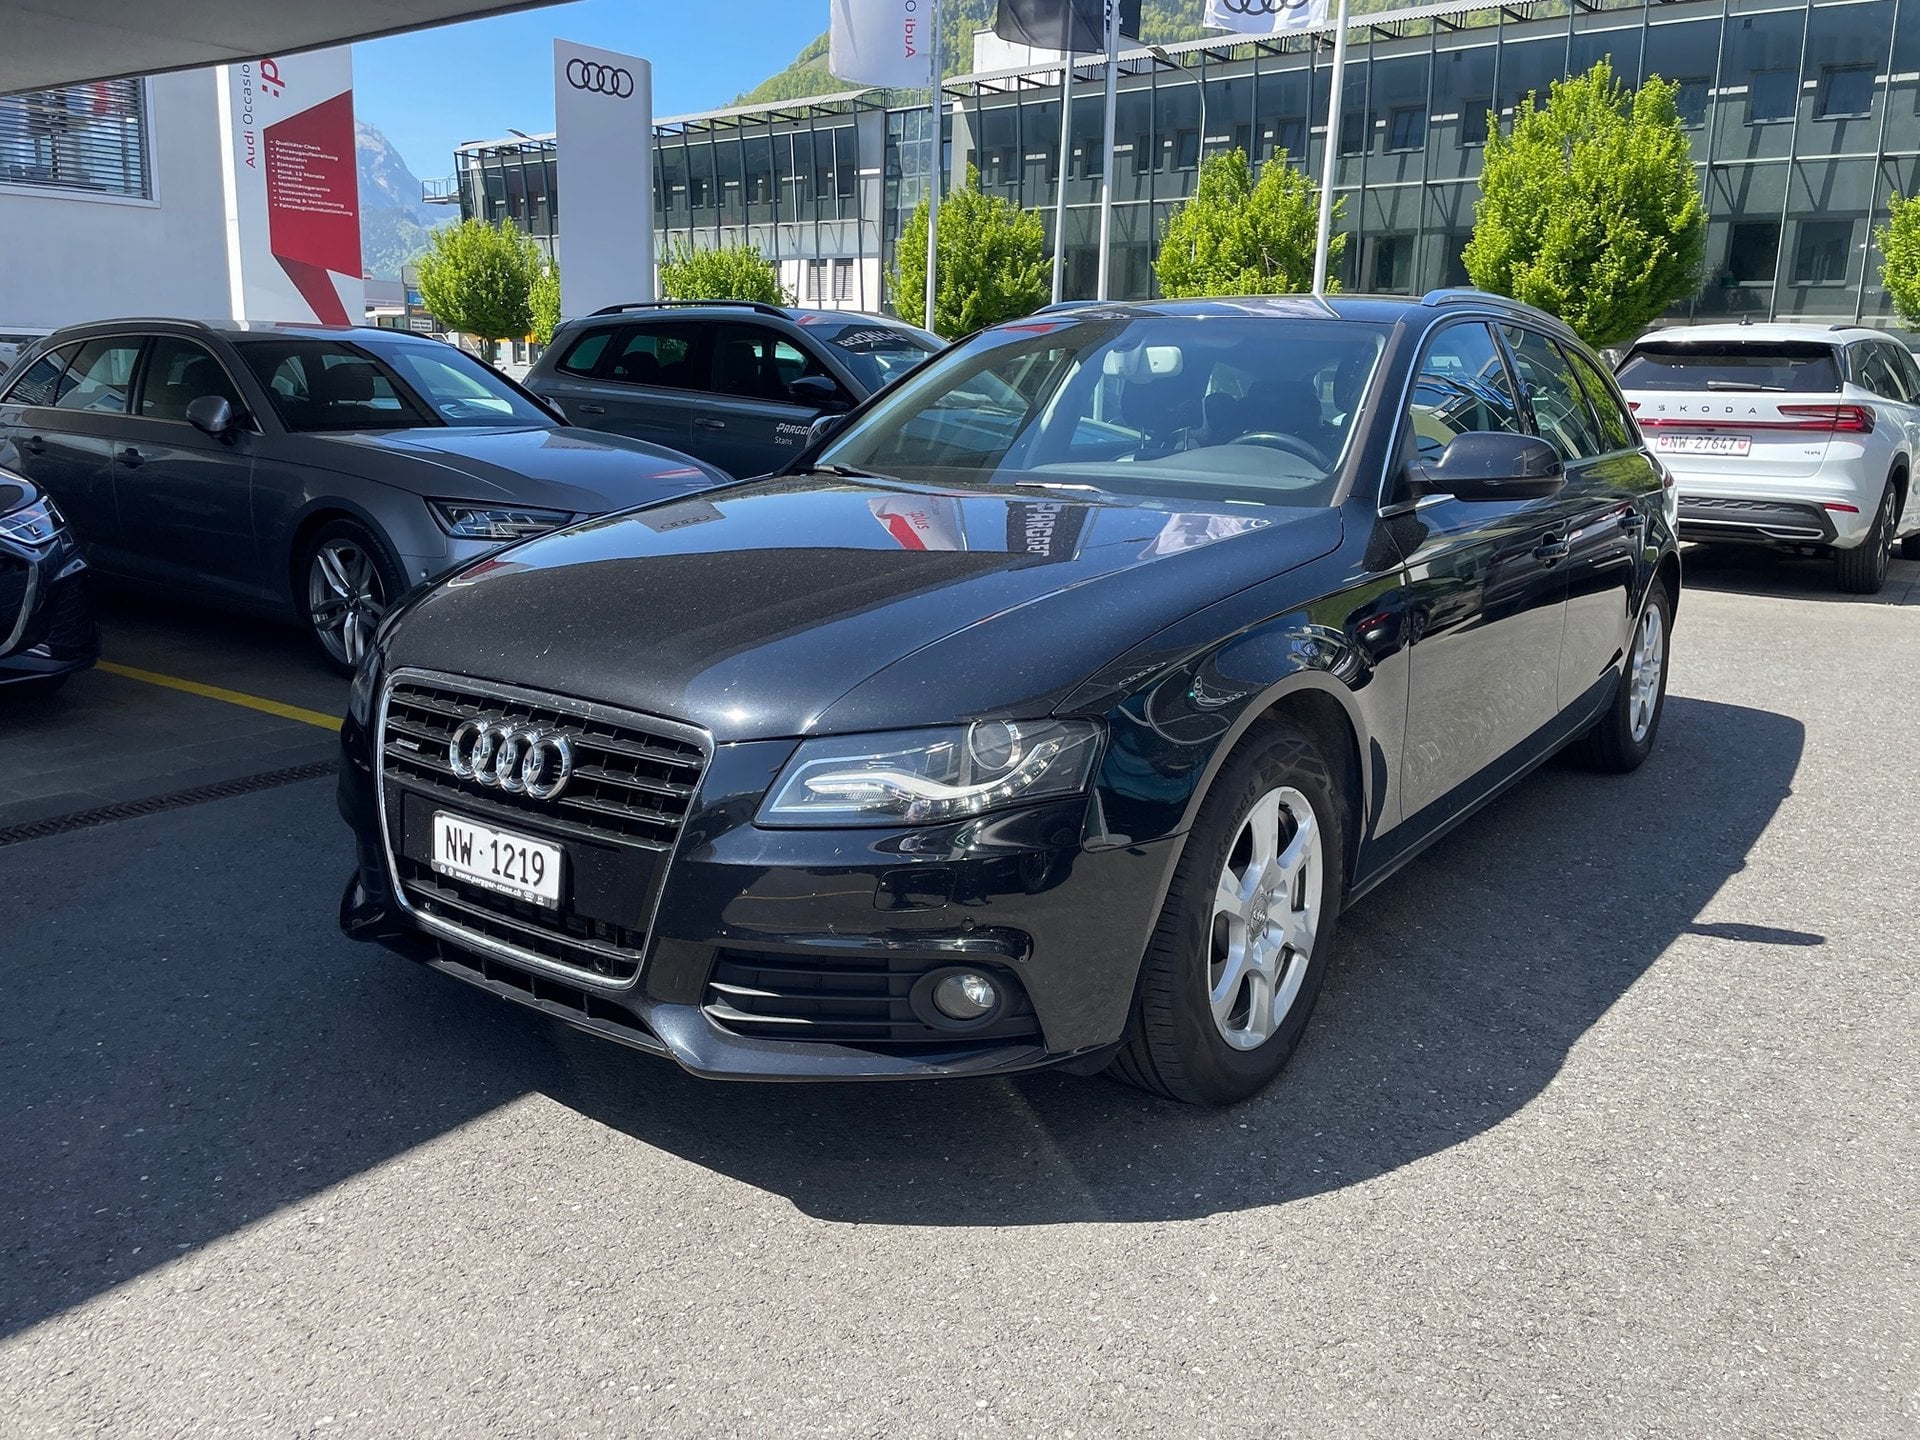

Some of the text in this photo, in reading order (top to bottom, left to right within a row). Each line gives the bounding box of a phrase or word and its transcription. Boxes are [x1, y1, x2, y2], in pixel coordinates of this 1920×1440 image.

[244, 130, 256, 168] Audi
[276, 155, 308, 163] Probefahrt
[277, 162, 305, 170] Eintausch
[277, 174, 303, 182] Garantie
[279, 195, 301, 204] Leasing
[308, 199, 345, 209] Versicherung
[774, 436, 793, 446] Stans
[1669, 435, 1737, 450] NW 27647
[446, 825, 545, 887] NW 1219
[455, 870, 522, 897] www.pargger-stans.ch
